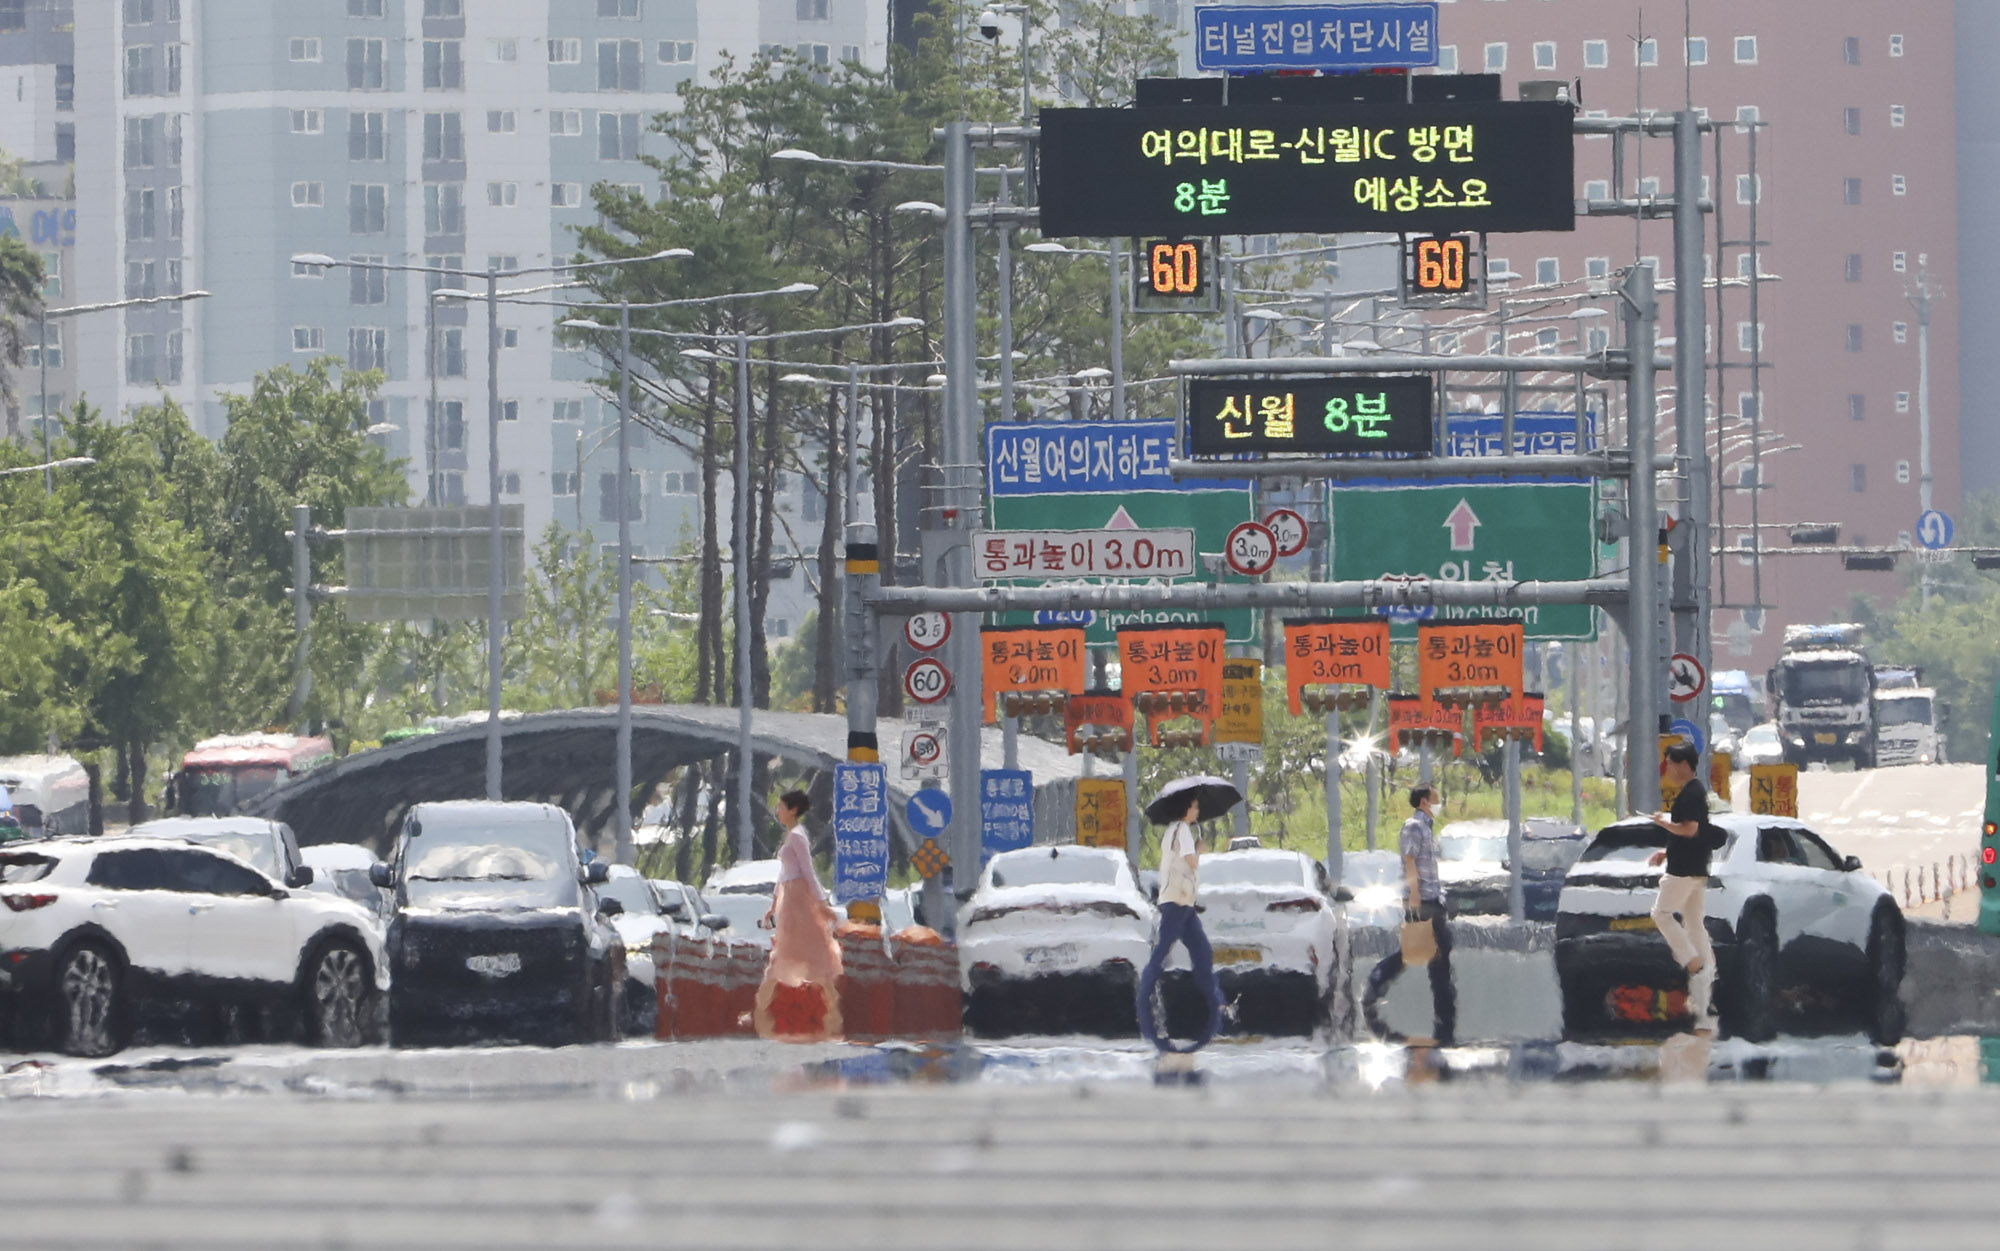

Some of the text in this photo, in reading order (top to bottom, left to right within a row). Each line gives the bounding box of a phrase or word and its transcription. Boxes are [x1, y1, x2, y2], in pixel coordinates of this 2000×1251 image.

[1204, 18, 1430, 55] 터널진입차단시설
[1141, 124, 1474, 166] 여의대로-신월IC 방면
[1173, 175, 1492, 216] 8분 예상소요
[1151, 242, 1198, 294] 60
[1418, 239, 1464, 291] 60
[1215, 392, 1394, 439] 신월 8분
[982, 537, 1184, 572] 통과높이 3.0m
[1235, 537, 1269, 558] 3.0m
[991, 638, 1078, 664] 통과높이
[1126, 638, 1218, 664] 통과높이
[1293, 632, 1382, 657] 통과높이
[1427, 631, 1517, 659] 통과높이
[913, 669, 941, 692] 60
[1008, 664, 1058, 685] 3.0m
[1148, 665, 1198, 685] 3.0m
[1313, 659, 1363, 679] 3.0m
[1448, 661, 1499, 682] 3.0m
